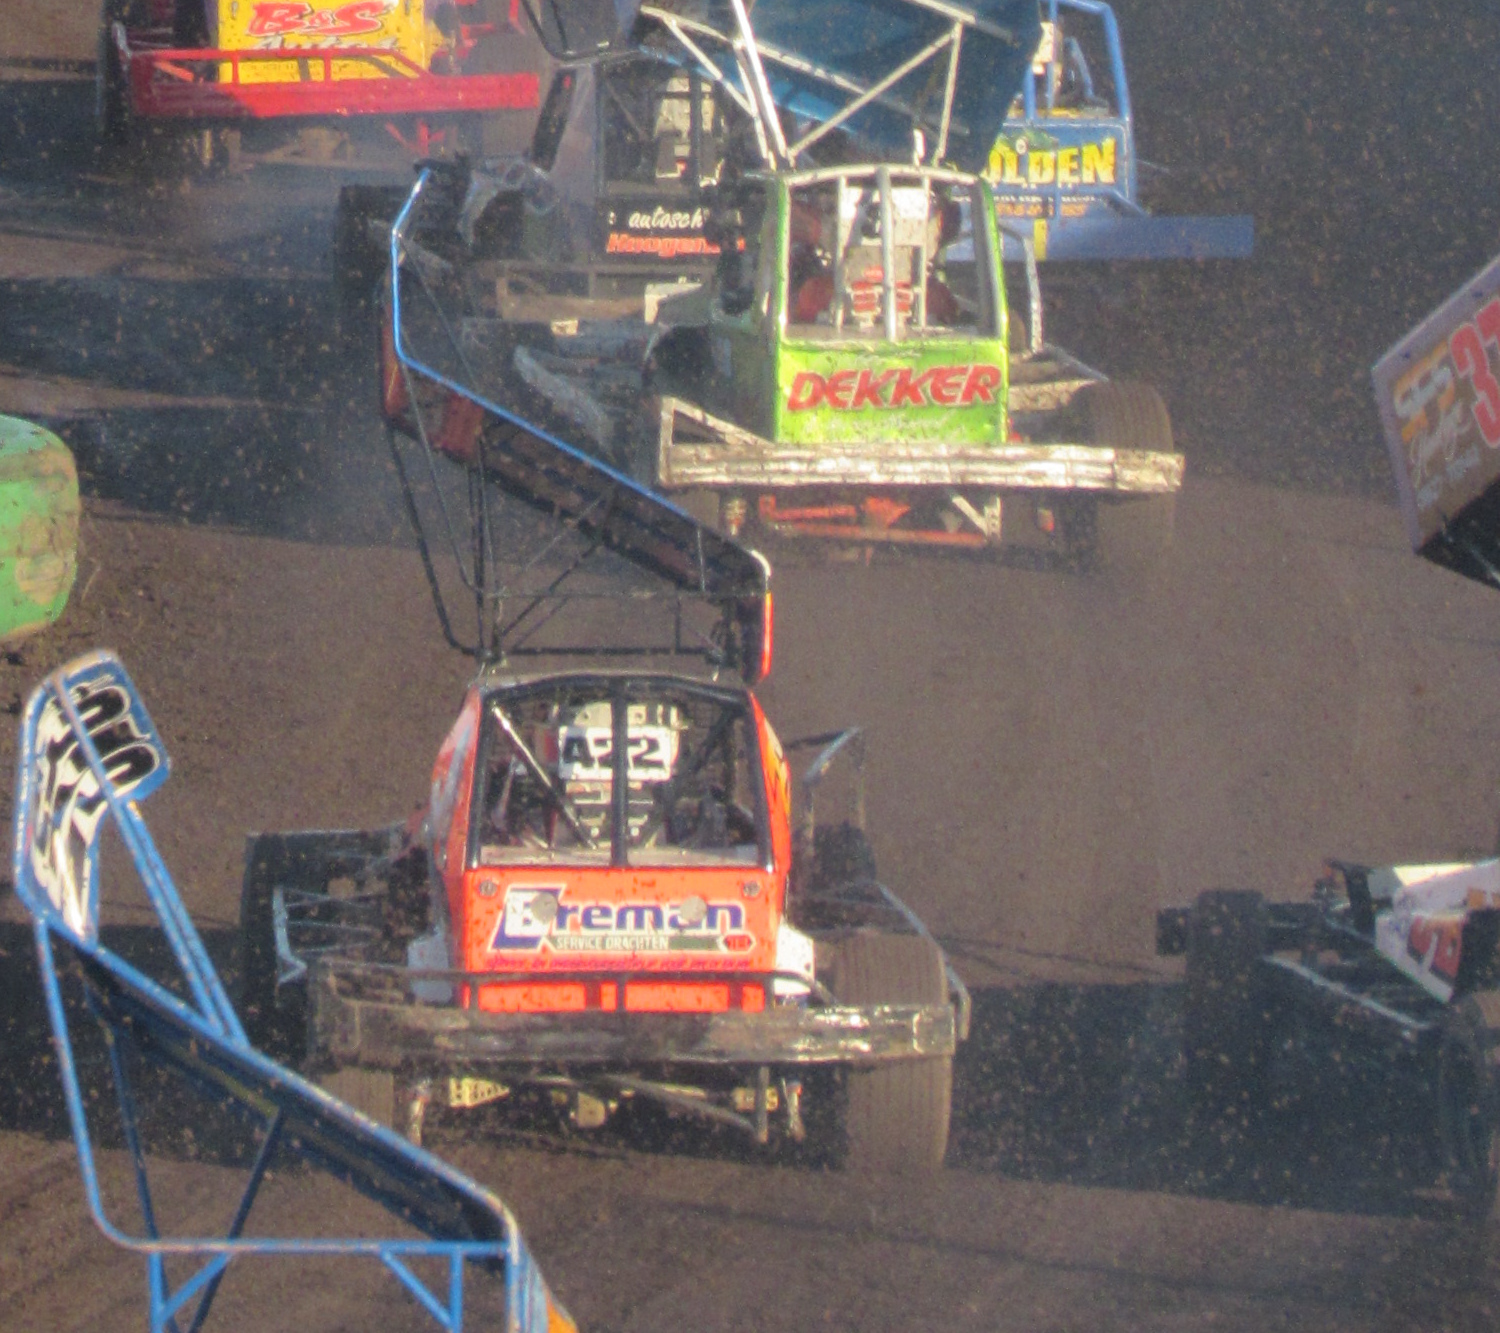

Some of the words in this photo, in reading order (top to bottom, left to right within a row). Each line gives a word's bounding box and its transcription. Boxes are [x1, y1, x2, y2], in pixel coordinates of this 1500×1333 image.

[786, 363, 1002, 412] DEKKER
[562, 735, 666, 769] A22
[496, 884, 744, 943] Breman
[556, 934, 602, 950] SERVICE
[604, 934, 669, 950] DRACHTEN
